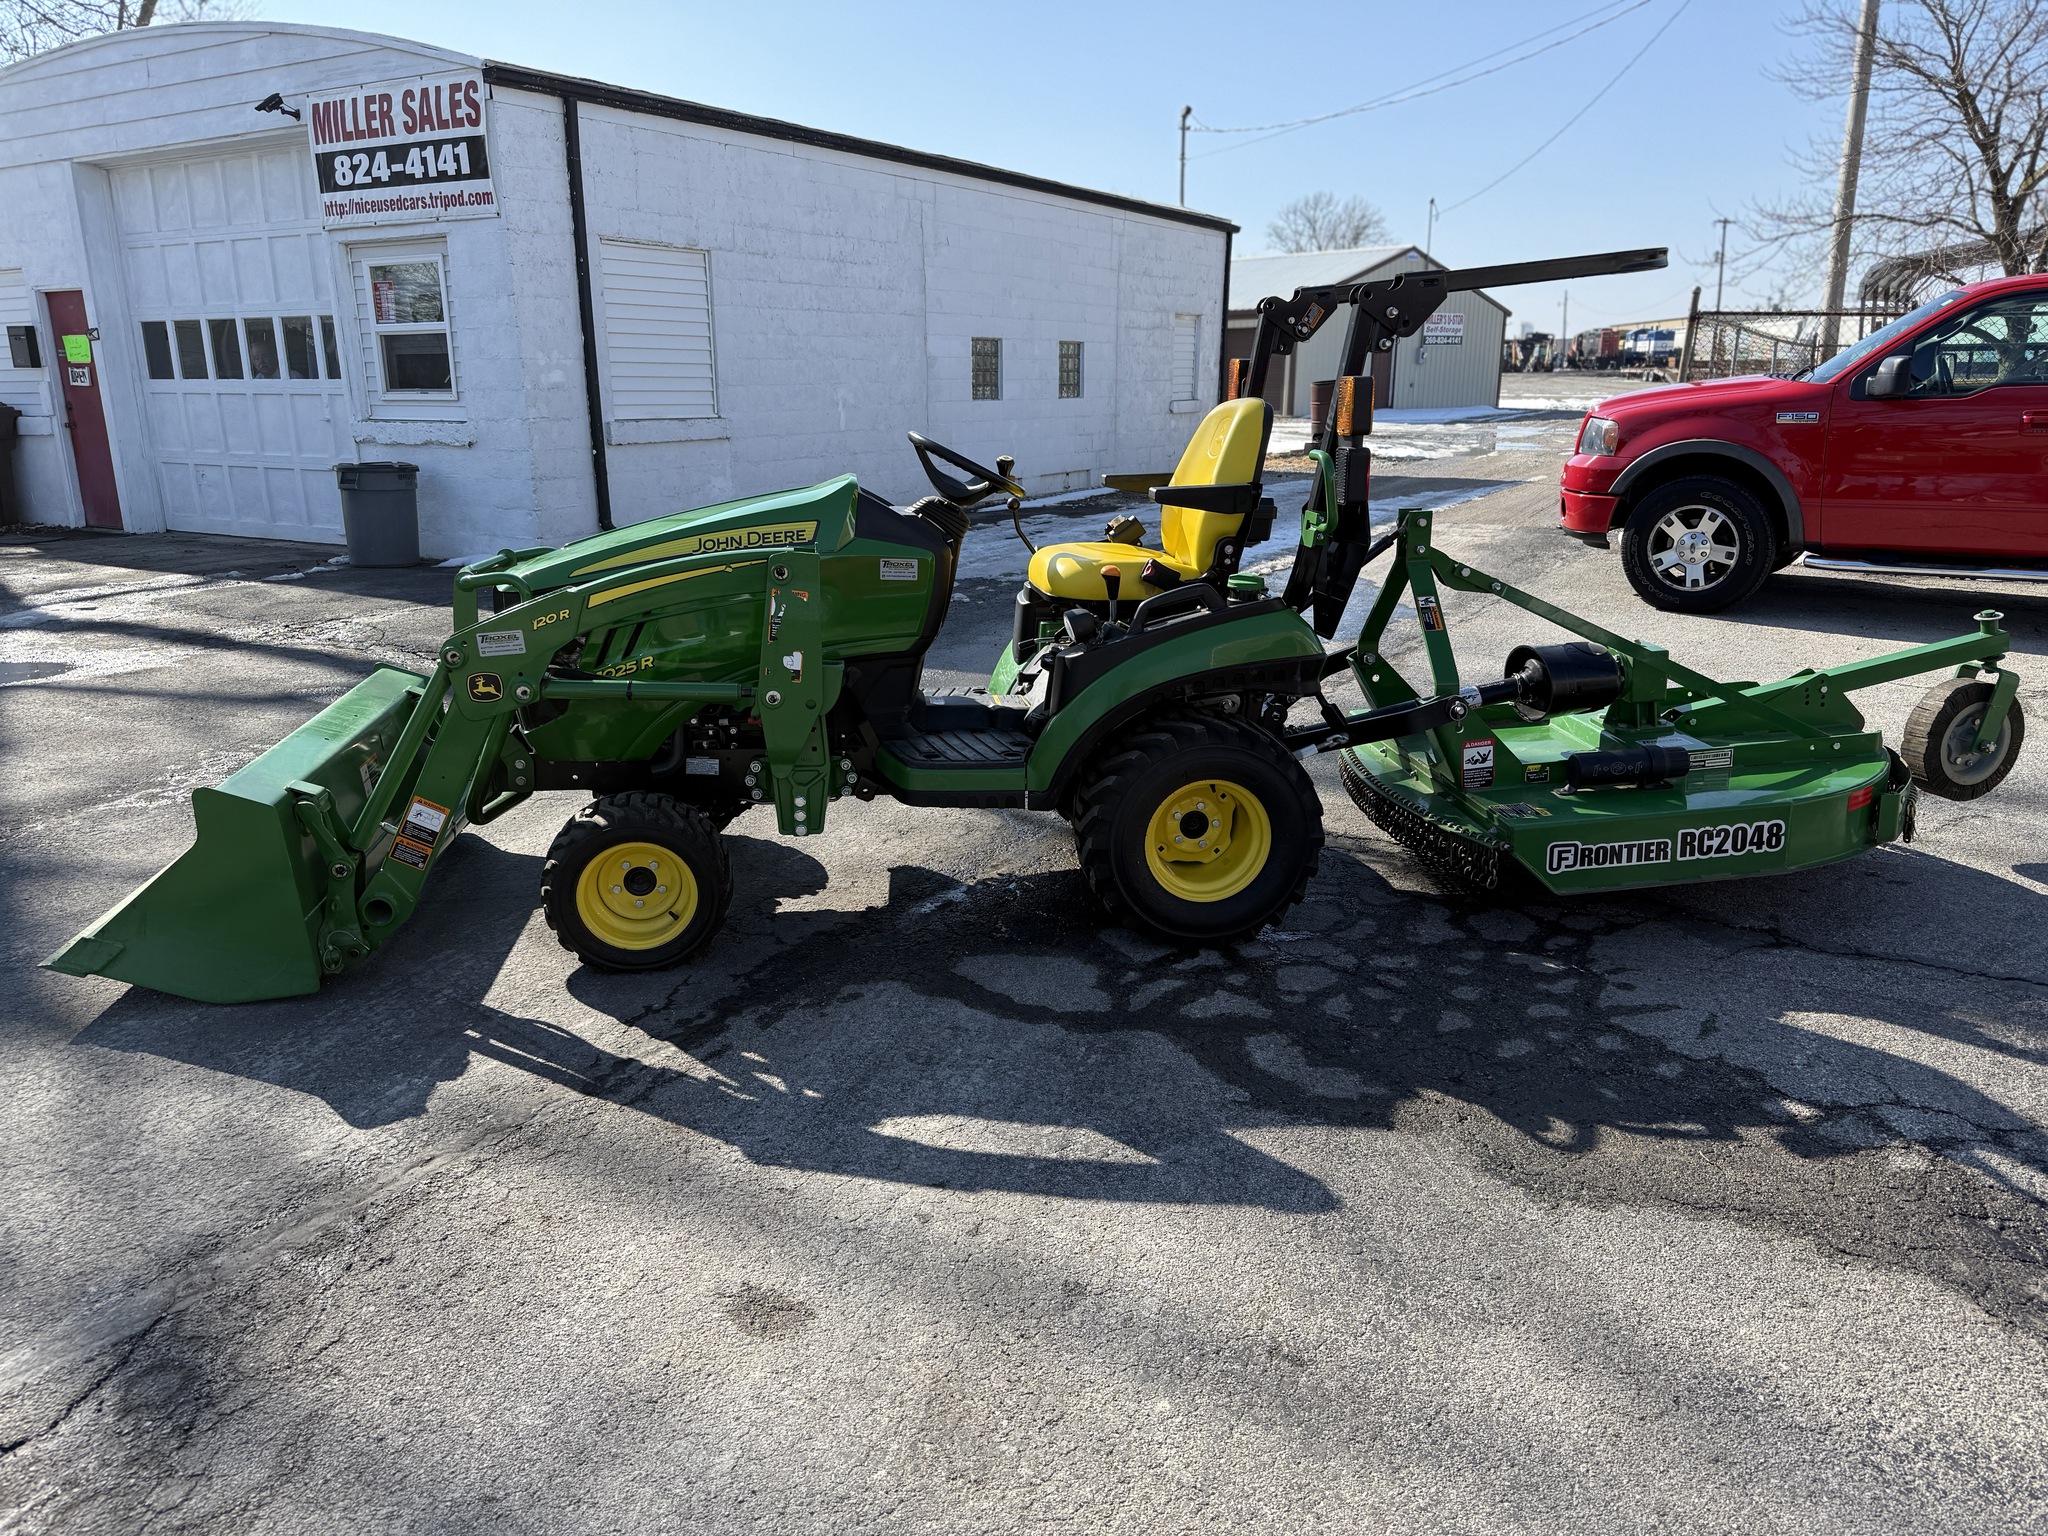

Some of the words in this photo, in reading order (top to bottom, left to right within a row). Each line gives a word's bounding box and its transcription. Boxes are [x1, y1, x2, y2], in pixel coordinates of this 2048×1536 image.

[312, 92, 396, 145] MILLER
[402, 80, 481, 135] SALES
[334, 142, 471, 186] 824-4141
[324, 189, 494, 218] http://niceusedcars.tripod.com
[1426, 326, 1461, 334] Self-Storage
[692, 535, 742, 553] JOHN
[747, 529, 806, 546] DEERE
[532, 613, 557, 630] 120
[559, 608, 570, 621] R
[641, 655, 654, 670] R
[423, 800, 446, 813] WARNING
[1549, 841, 1669, 872] FRONTIER
[1680, 822, 1783, 858] RC2048
